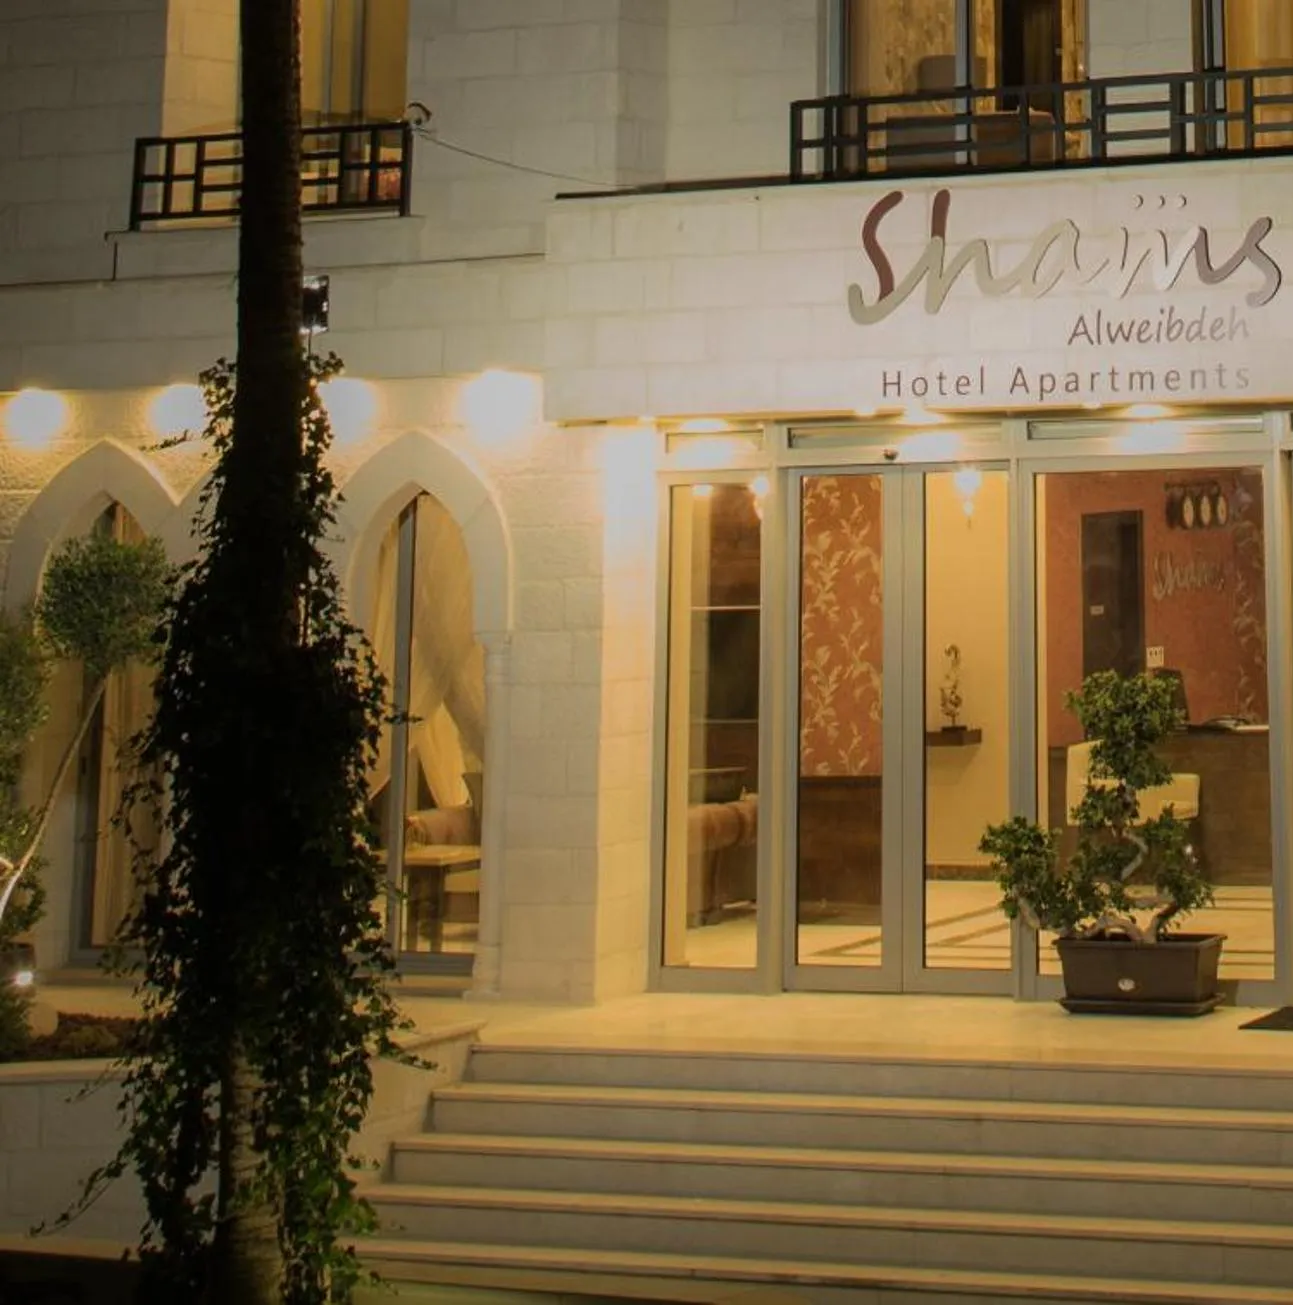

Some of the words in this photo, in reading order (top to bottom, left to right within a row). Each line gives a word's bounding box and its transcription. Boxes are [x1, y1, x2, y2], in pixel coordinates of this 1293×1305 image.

[1068, 305, 1249, 346] Alweibdeh
[882, 366, 985, 397] Hotel
[1010, 362, 1250, 401] Apartments
